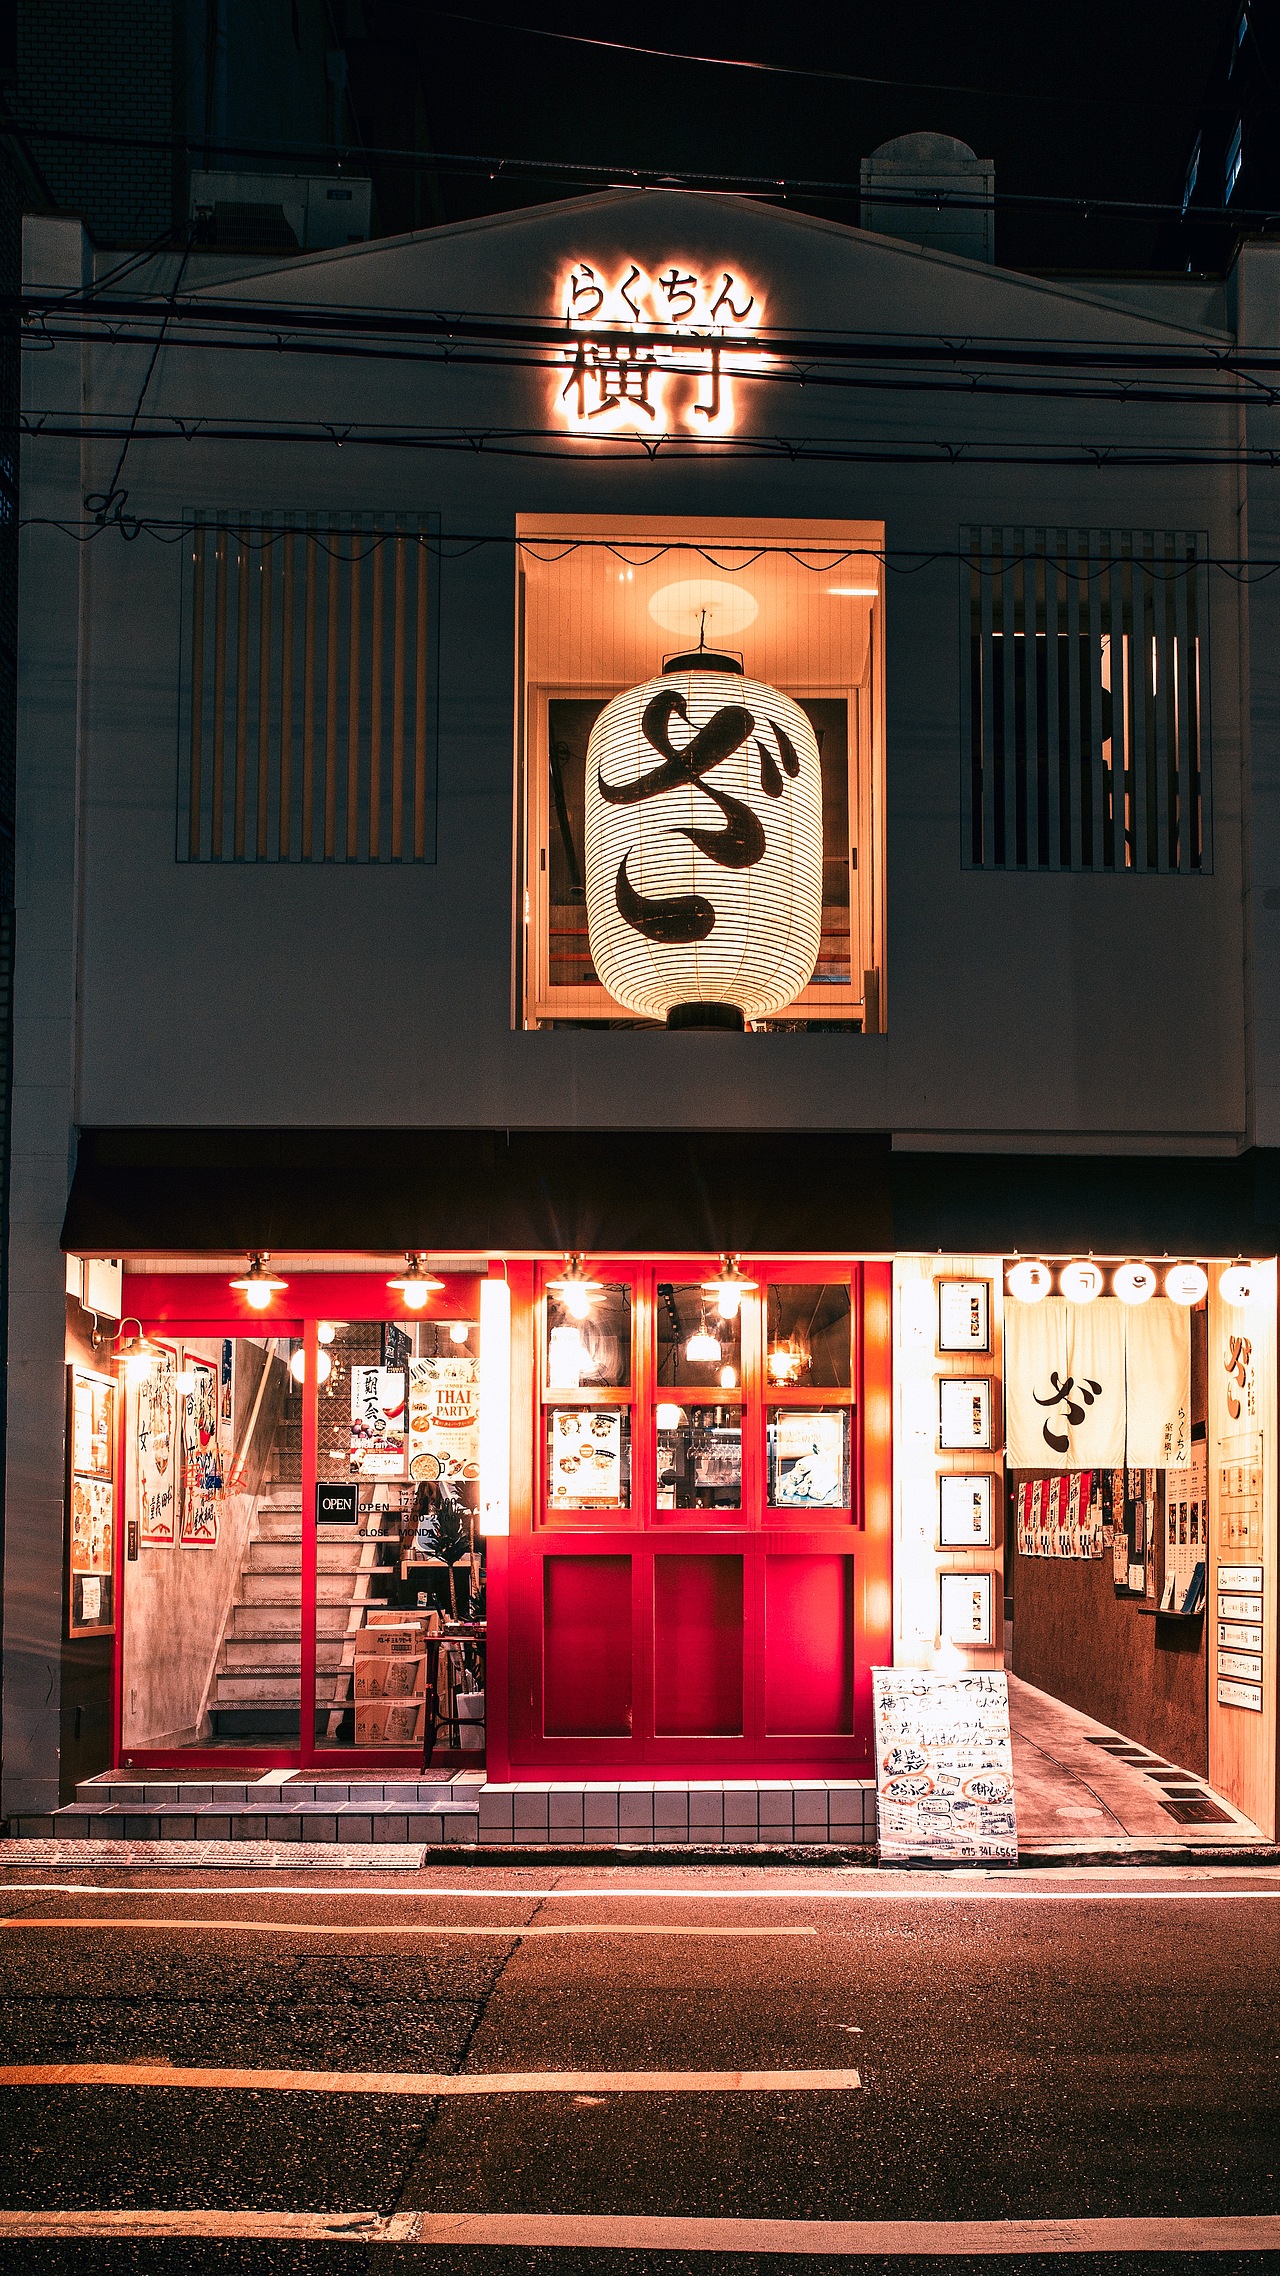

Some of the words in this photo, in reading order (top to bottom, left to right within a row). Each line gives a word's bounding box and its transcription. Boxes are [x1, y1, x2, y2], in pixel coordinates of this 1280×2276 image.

[570, 263, 754, 322] らくちん
[562, 338, 722, 422] 横丁
[362, 1368, 379, 1420] 一期一会
[435, 1389, 471, 1404] THAI
[436, 1405, 471, 1416] PARTY
[1176, 1407, 1186, 1461] らくちん
[322, 1498, 352, 1510] OPEN
[359, 1503, 390, 1511] OPEN
[358, 1529, 390, 1537] CLOSE
[398, 1529, 438, 1537] MONDA
[357, 1678, 365, 1686] 24
